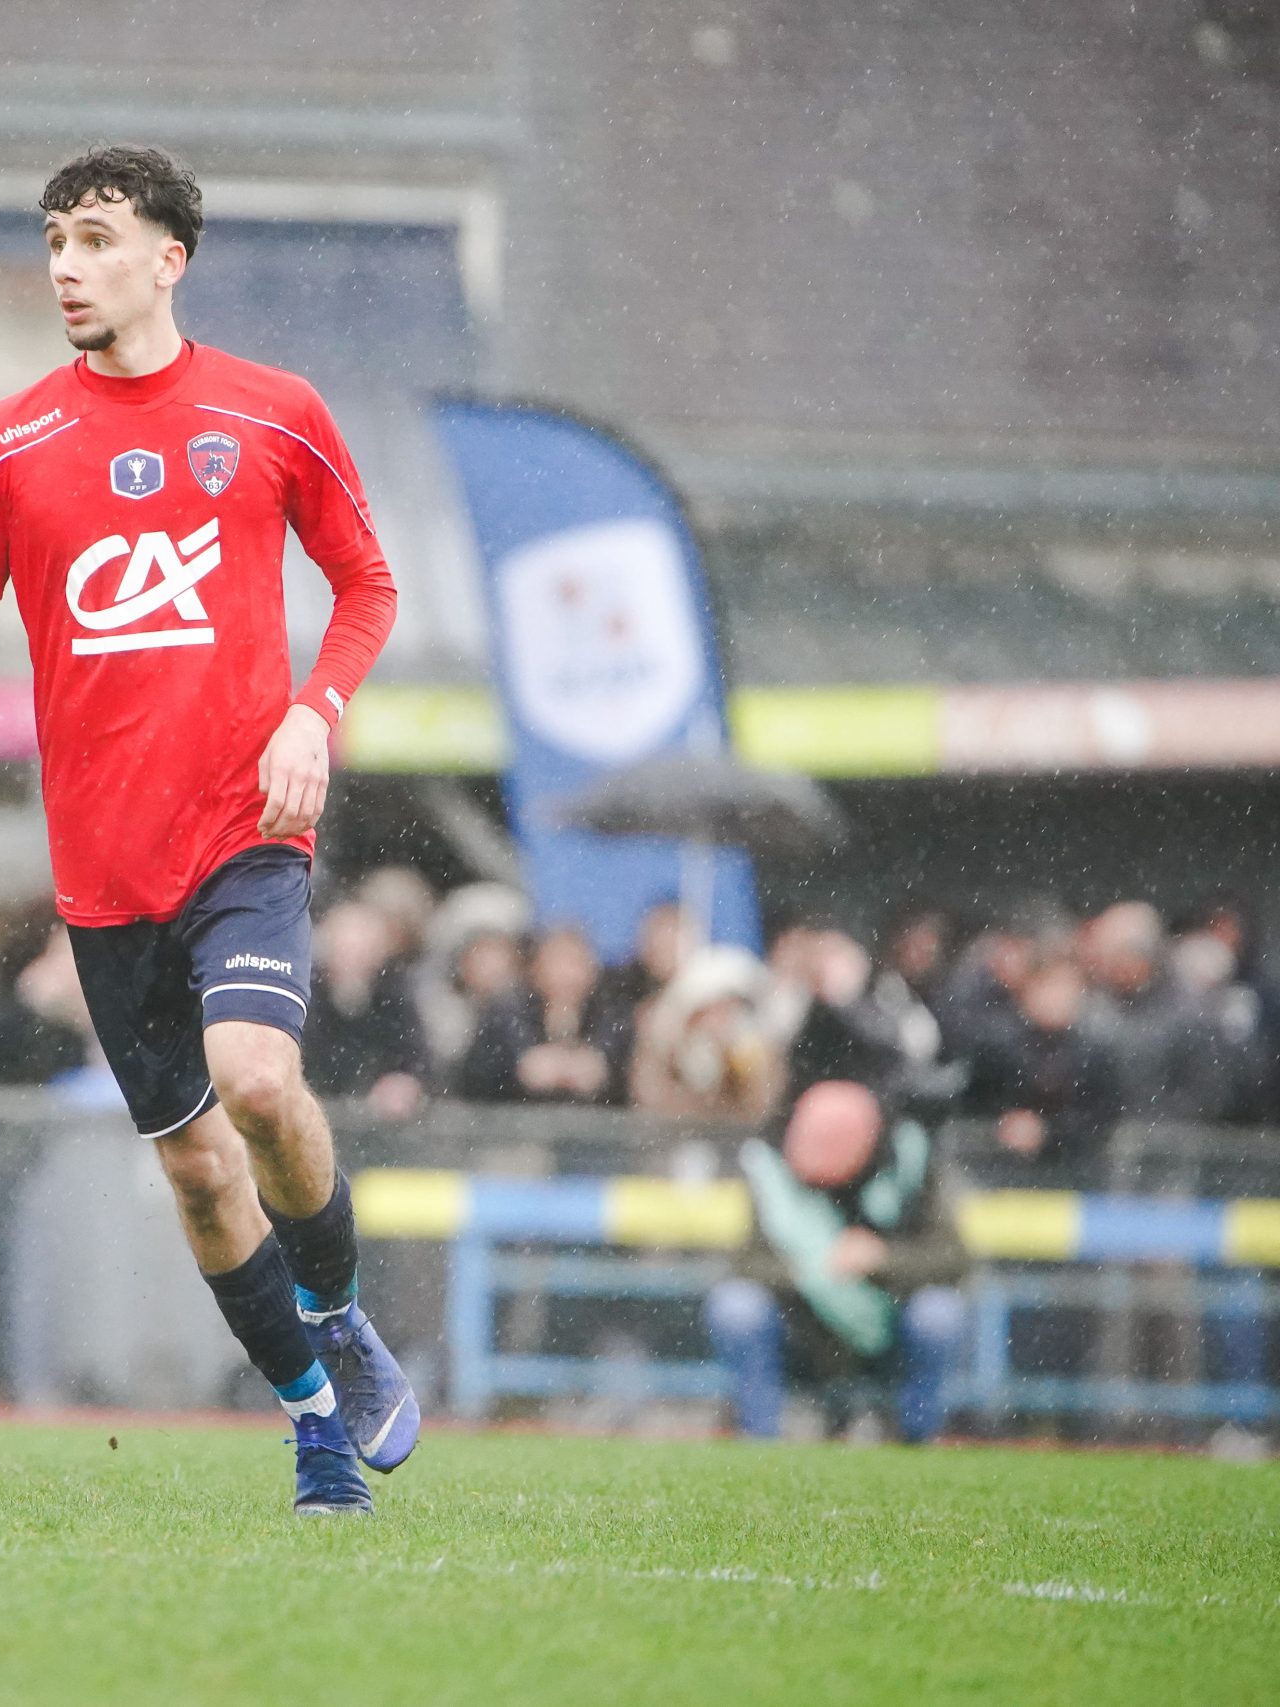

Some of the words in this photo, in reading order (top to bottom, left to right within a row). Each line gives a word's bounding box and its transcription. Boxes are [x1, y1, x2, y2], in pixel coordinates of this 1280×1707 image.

[192, 435, 220, 449] CLERMONT
[220, 437, 235, 449] FOOT
[208, 481, 220, 490] 63
[225, 953, 293, 976] uhlsport
